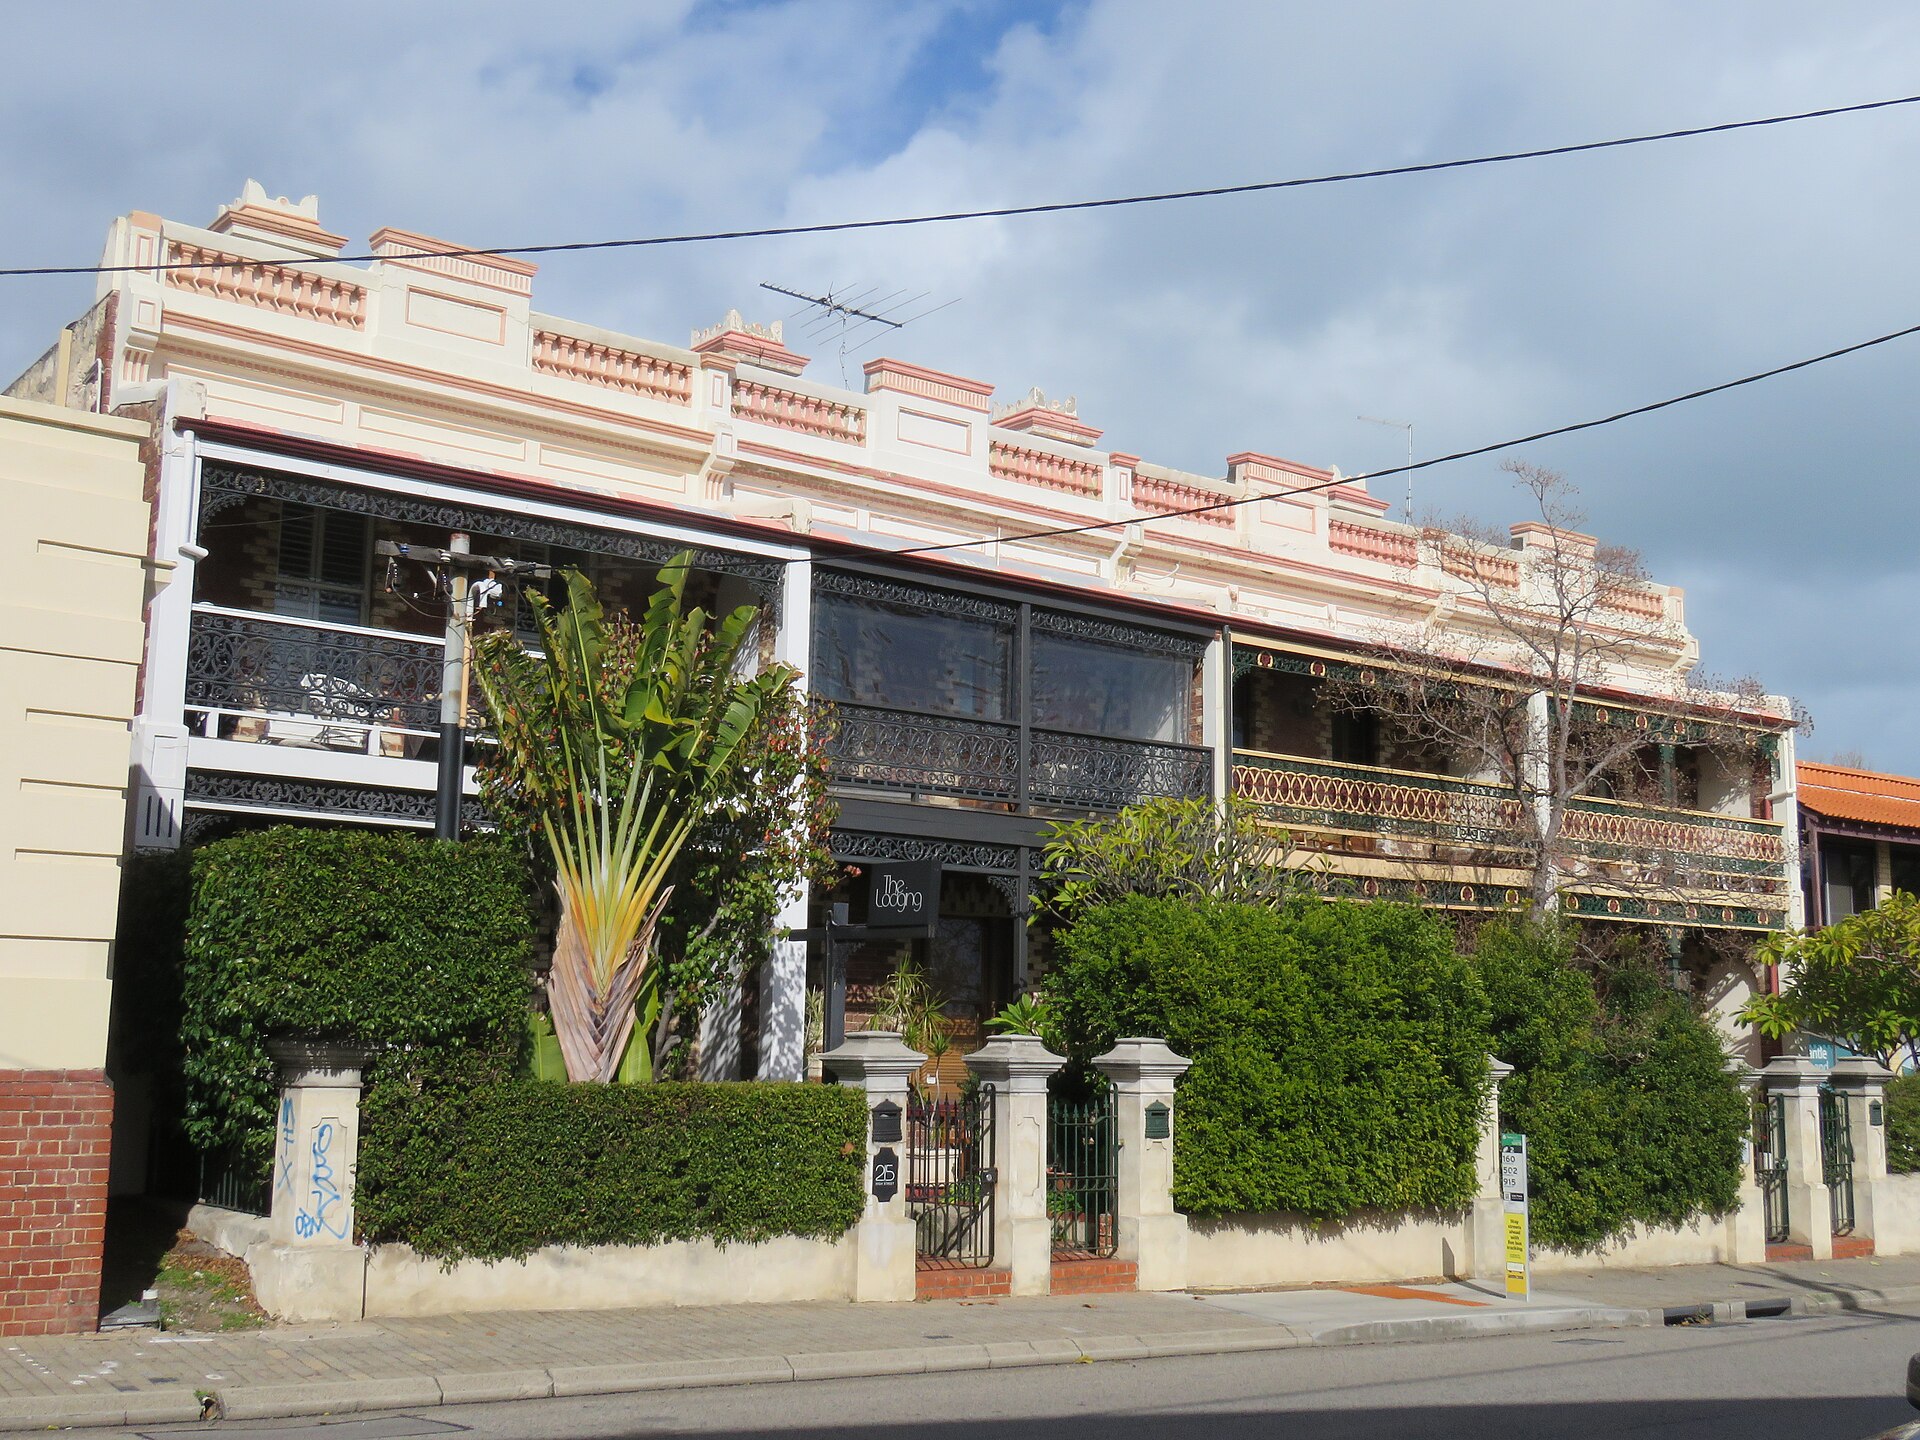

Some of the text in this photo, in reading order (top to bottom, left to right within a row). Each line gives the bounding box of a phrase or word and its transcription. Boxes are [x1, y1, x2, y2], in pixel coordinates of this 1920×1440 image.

[883, 874, 905, 894] The
[875, 888, 923, 913] Lodging
[1502, 1155, 1516, 1163] 160
[875, 1164, 896, 1182] 25
[1503, 1166, 1518, 1175] 502
[1503, 1178, 1516, 1186] 915
